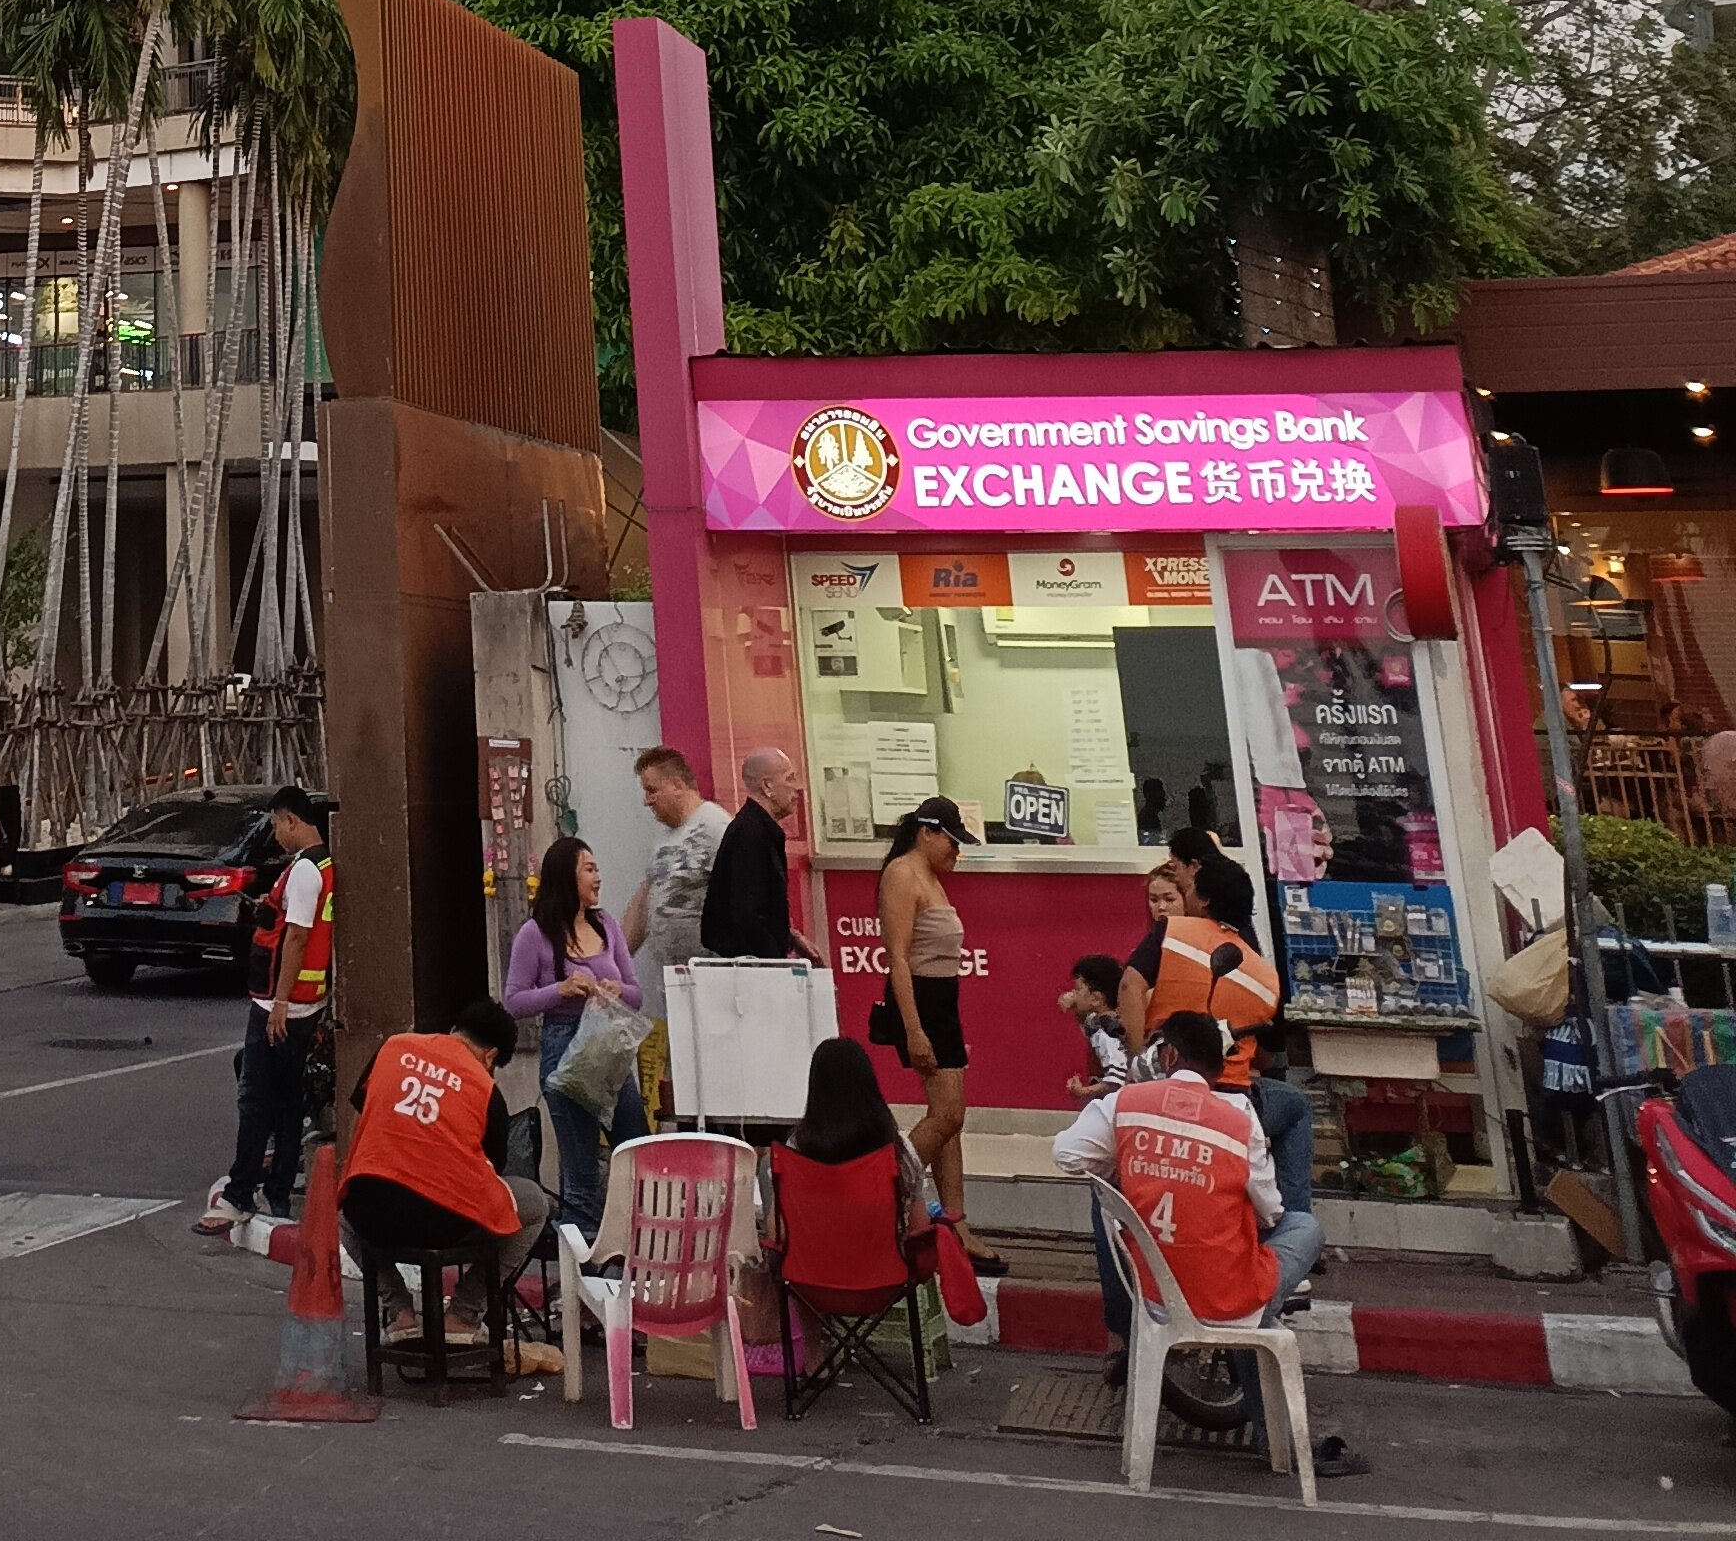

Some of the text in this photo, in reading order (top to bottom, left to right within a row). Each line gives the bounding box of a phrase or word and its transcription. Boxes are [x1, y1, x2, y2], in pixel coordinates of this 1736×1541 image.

[906, 410, 1369, 451] Government Savings Bank
[912, 457, 1378, 508] EXCHANGE 货币兑换
[811, 574, 857, 587] SPEED
[932, 559, 979, 589] Ria
[1035, 579, 1102, 592] MoneyGram
[1256, 573, 1376, 607] ATM
[1315, 688, 1399, 725] ครั้งแรก
[1367, 756, 1406, 774] ATM
[1010, 793, 1065, 826] OPEN
[400, 1052, 463, 1093] CIMB
[393, 1075, 446, 1125] 25
[1134, 1130, 1214, 1166] CIMB
[1149, 1190, 1178, 1244] 4
